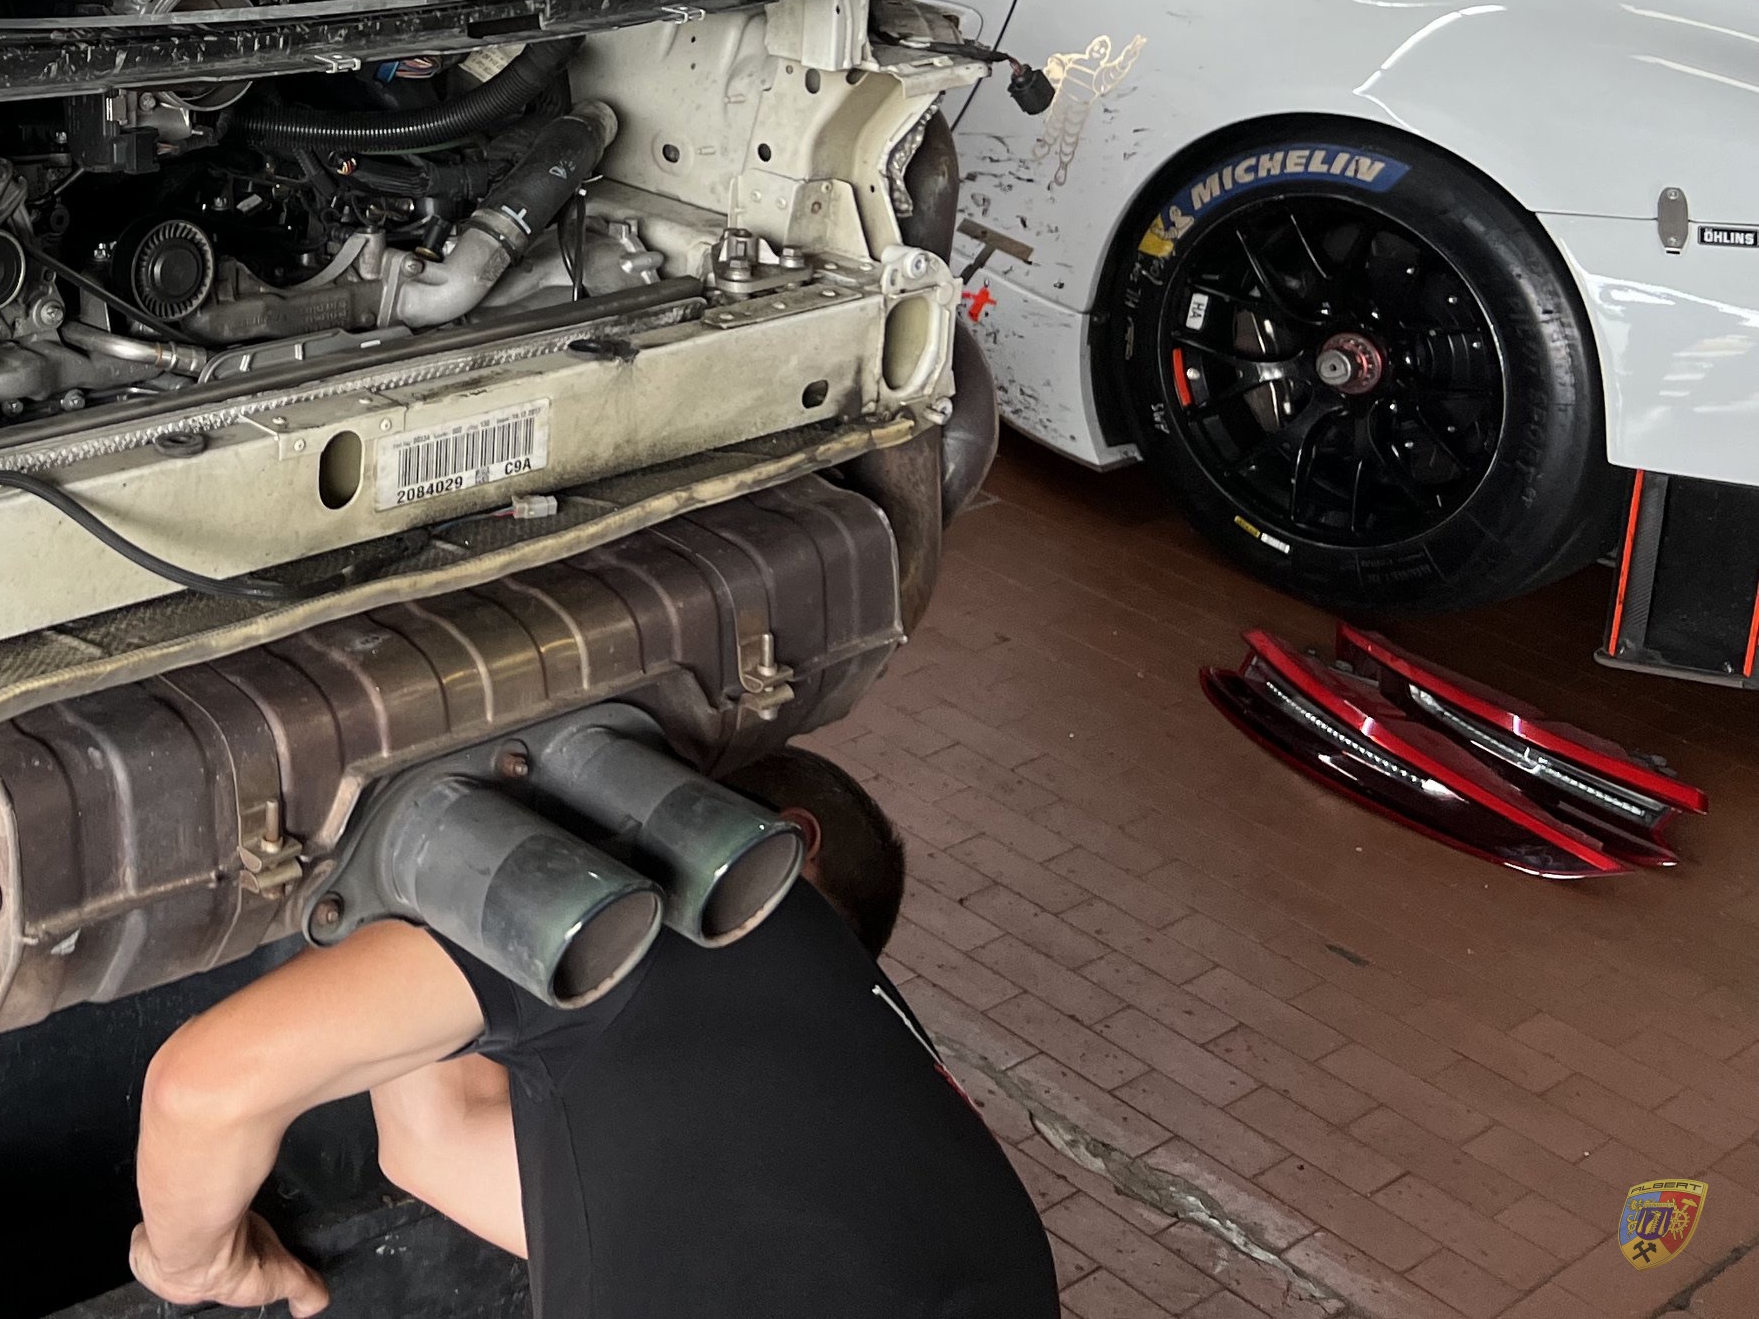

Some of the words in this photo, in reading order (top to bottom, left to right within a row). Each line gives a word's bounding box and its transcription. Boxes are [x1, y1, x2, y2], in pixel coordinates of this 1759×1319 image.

[1191, 150, 1385, 210] MICHELIN
[1704, 228, 1754, 245] ÖHLINS
[396, 476, 463, 504] 2084029
[504, 457, 532, 476] C9A
